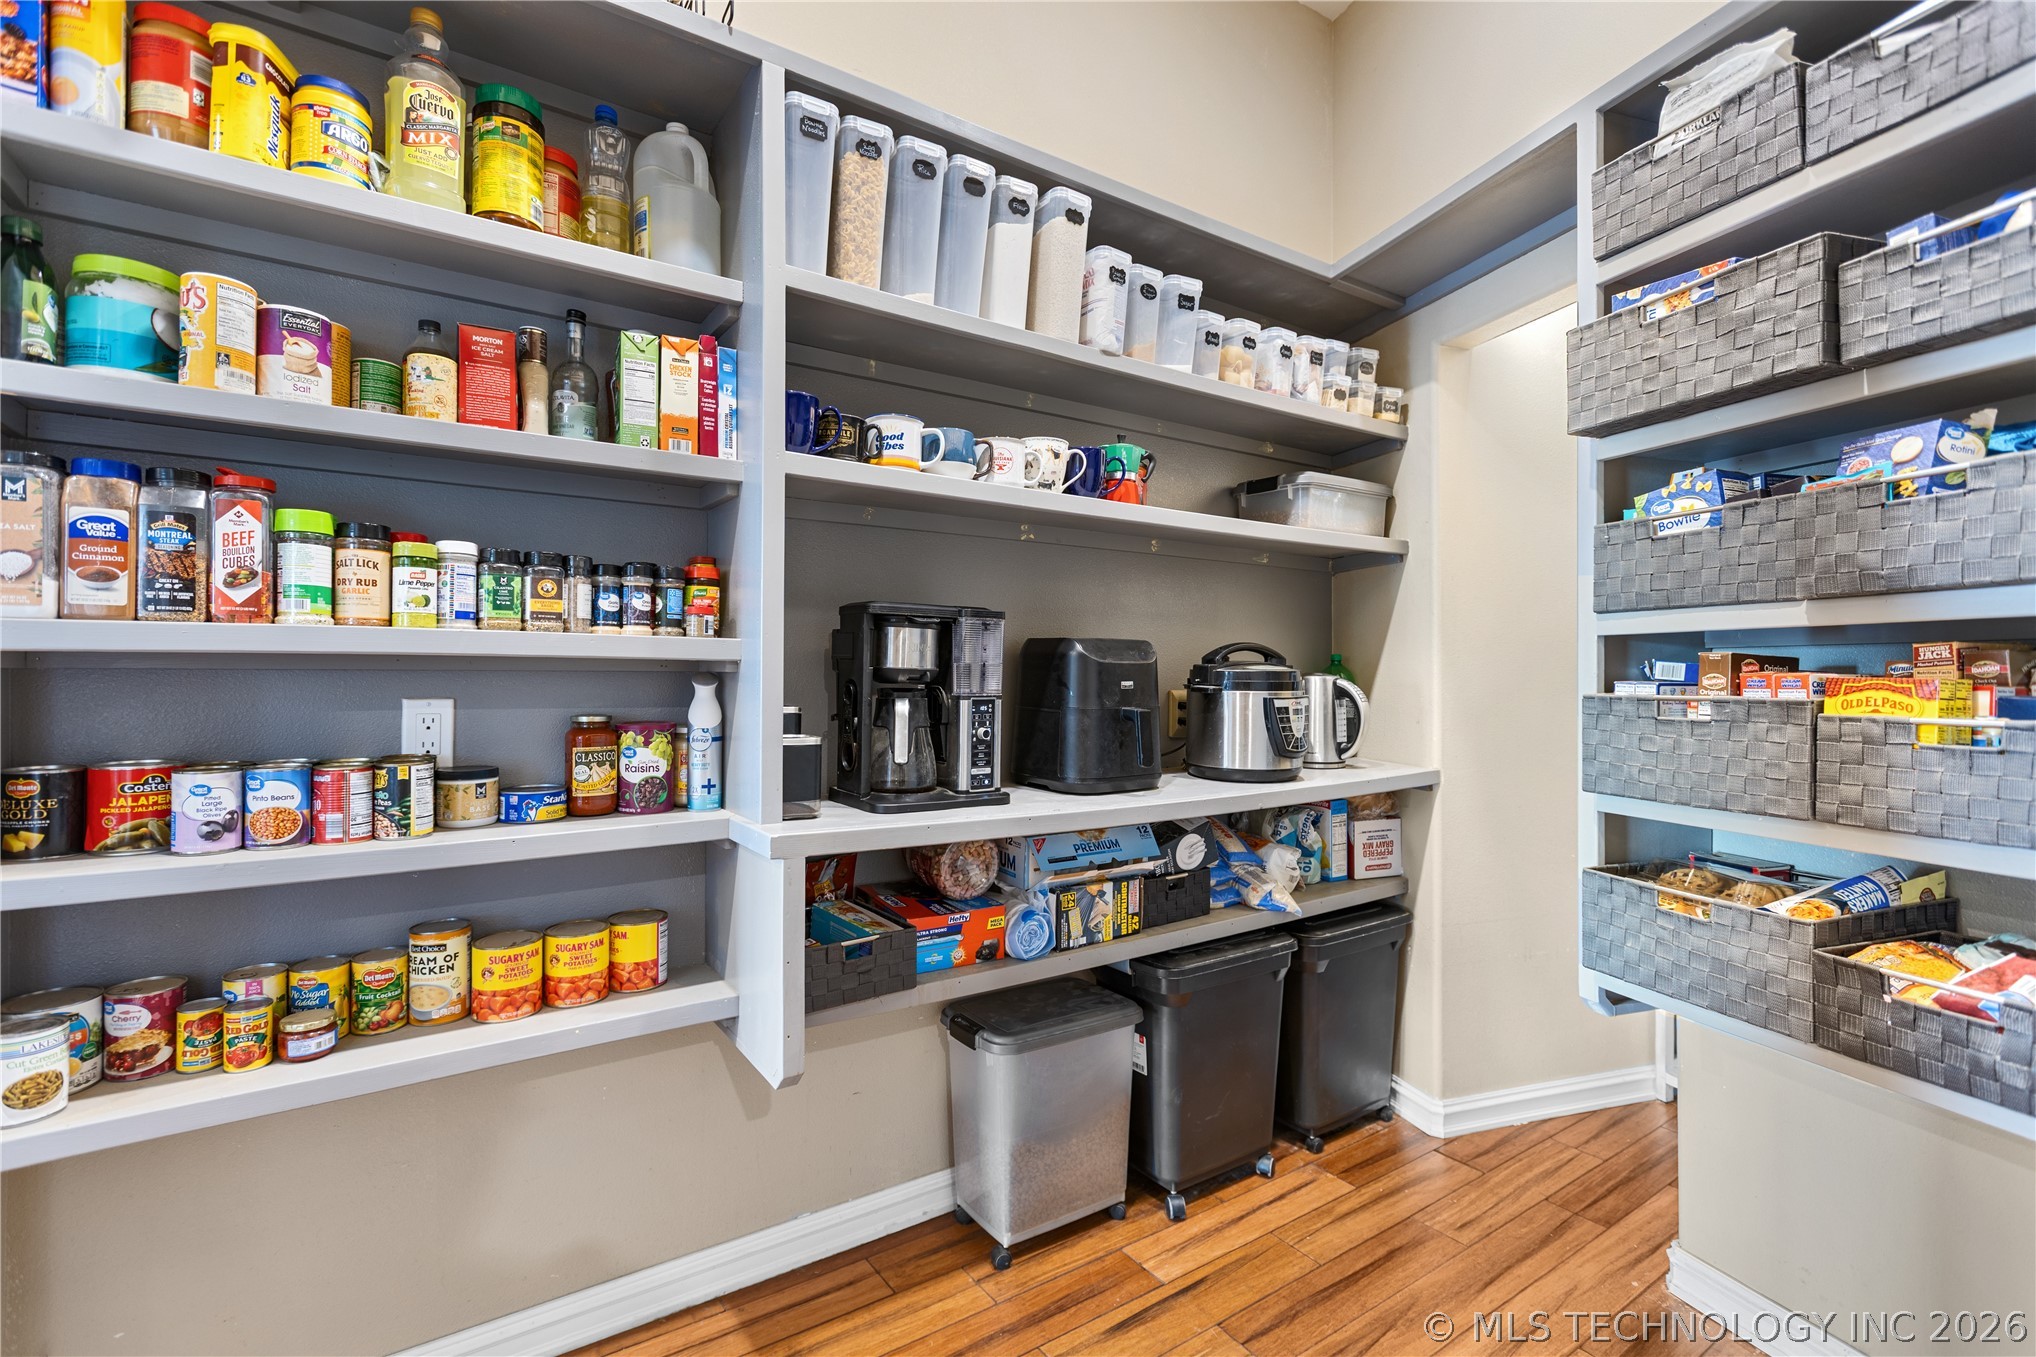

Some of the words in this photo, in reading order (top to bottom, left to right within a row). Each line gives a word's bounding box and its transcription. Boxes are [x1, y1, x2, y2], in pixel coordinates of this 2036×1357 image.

[425, 89, 443, 103] Jose
[409, 93, 454, 121] Cuervo
[267, 95, 282, 160] Nesquik
[428, 124, 458, 134] MARGARITA
[327, 123, 369, 154] ARGO
[408, 131, 453, 144] MIX
[327, 146, 347, 165] CORN
[414, 147, 432, 156] JUST
[434, 153, 449, 162] ADD
[218, 283, 242, 297] Nutrition
[243, 290, 255, 301] Facts
[282, 313, 320, 329] Essential
[283, 322, 320, 335] EVERYDAY
[472, 335, 503, 346] MORTON
[669, 364, 692, 372] CHICKEN
[283, 372, 319, 386] Iodized
[670, 370, 691, 378] STOCK
[292, 383, 311, 394] Salt
[1950, 443, 1976, 455] Rotini
[15, 523, 36, 531] SALT
[76, 519, 116, 533] Great
[153, 521, 166, 529] Grill
[167, 522, 186, 530] Mates
[86, 528, 117, 538] Value
[147, 529, 193, 540] MONTREAL
[222, 530, 255, 547] BEEF
[79, 544, 117, 554] Ground
[222, 546, 255, 556] BOUILLON
[71, 552, 125, 562] Cinnamon
[222, 554, 255, 569] CUBES
[336, 559, 354, 570] SALT
[356, 559, 380, 571] LICK
[337, 578, 353, 586] DRY
[356, 579, 377, 587] RUB
[1917, 649, 1952, 660] JACK
[1918, 645, 1950, 653] HUNGRY
[1763, 664, 1789, 673] Original
[1972, 664, 2000, 674] IDAHOAN
[1699, 689, 1727, 697] Original
[1841, 699, 1863, 711] OLD
[1865, 696, 1880, 707] EL
[1881, 697, 1914, 714] Paso
[691, 735, 711, 744] febreze
[575, 751, 616, 762] CLASSICO
[624, 763, 660, 773] Raisins
[148, 776, 161, 784] La
[576, 780, 598, 789] ROASTED
[599, 775, 613, 787] GARLIC
[124, 783, 172, 793] Costeñ
[109, 794, 172, 808] JALAPE
[201, 800, 222, 808] Large
[542, 793, 568, 805] StarKi
[1, 809, 48, 820] GOLD
[545, 808, 560, 816] Solid
[1136, 825, 1150, 834] 12
[1005, 837, 1013, 846] 12
[1072, 838, 1121, 853] PREMIUM
[1362, 841, 1375, 850] MIX
[1376, 840, 1394, 849] GRAVY
[1362, 848, 1394, 858] PEPPERED
[1303, 859, 1312, 873] 10
[1833, 880, 1879, 901] WANTED
[1067, 893, 1075, 908] 24
[1847, 890, 1886, 913] MAKERS
[949, 914, 969, 923] Hefty
[1132, 915, 1139, 930] 42
[612, 931, 627, 940] SAM
[555, 941, 588, 953] SUGARY
[589, 937, 604, 948] SAM
[409, 956, 437, 966] REAM
[443, 952, 460, 963] OF
[489, 952, 525, 966] SUGARY
[569, 952, 593, 961] SWEET
[563, 958, 598, 967] POTATOES
[498, 968, 534, 980] POTATOES
[504, 963, 529, 974] SWEET
[374, 971, 395, 981] Monte
[291, 990, 302, 999] No
[301, 989, 330, 1000] Sugar
[376, 989, 402, 999] Cocktail
[295, 999, 320, 1007] Added
[111, 1014, 142, 1025] Cherry
[226, 1025, 242, 1035] RED
[243, 1019, 269, 1034] GOLD
[194, 1036, 217, 1047] PASTE
[234, 1036, 257, 1045] PASTE
[182, 1047, 209, 1058] GOLD
[6, 1060, 25, 1070] Cut
[29, 1052, 58, 1067] Green
